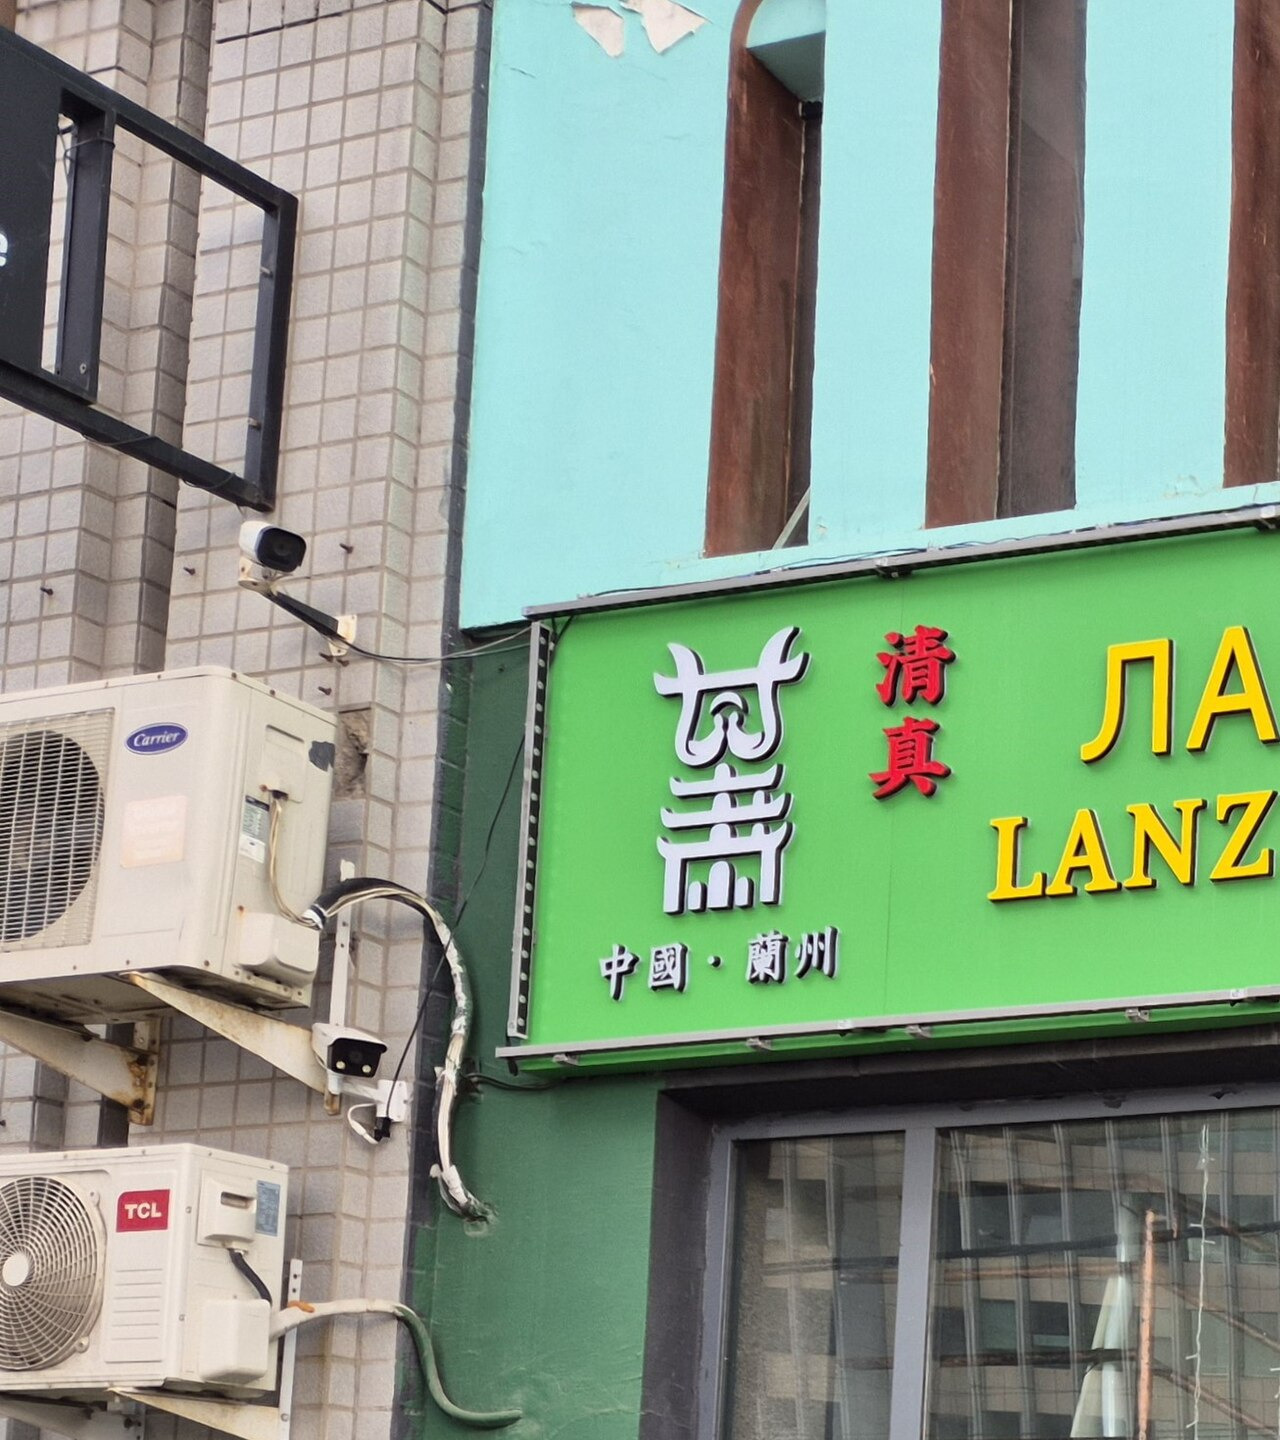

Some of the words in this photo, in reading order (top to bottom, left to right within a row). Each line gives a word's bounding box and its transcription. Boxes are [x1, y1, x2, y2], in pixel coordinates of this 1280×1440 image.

[868, 624, 956, 800] 清真
[133, 730, 181, 747] Carrier
[124, 1202, 162, 1219] TCL
